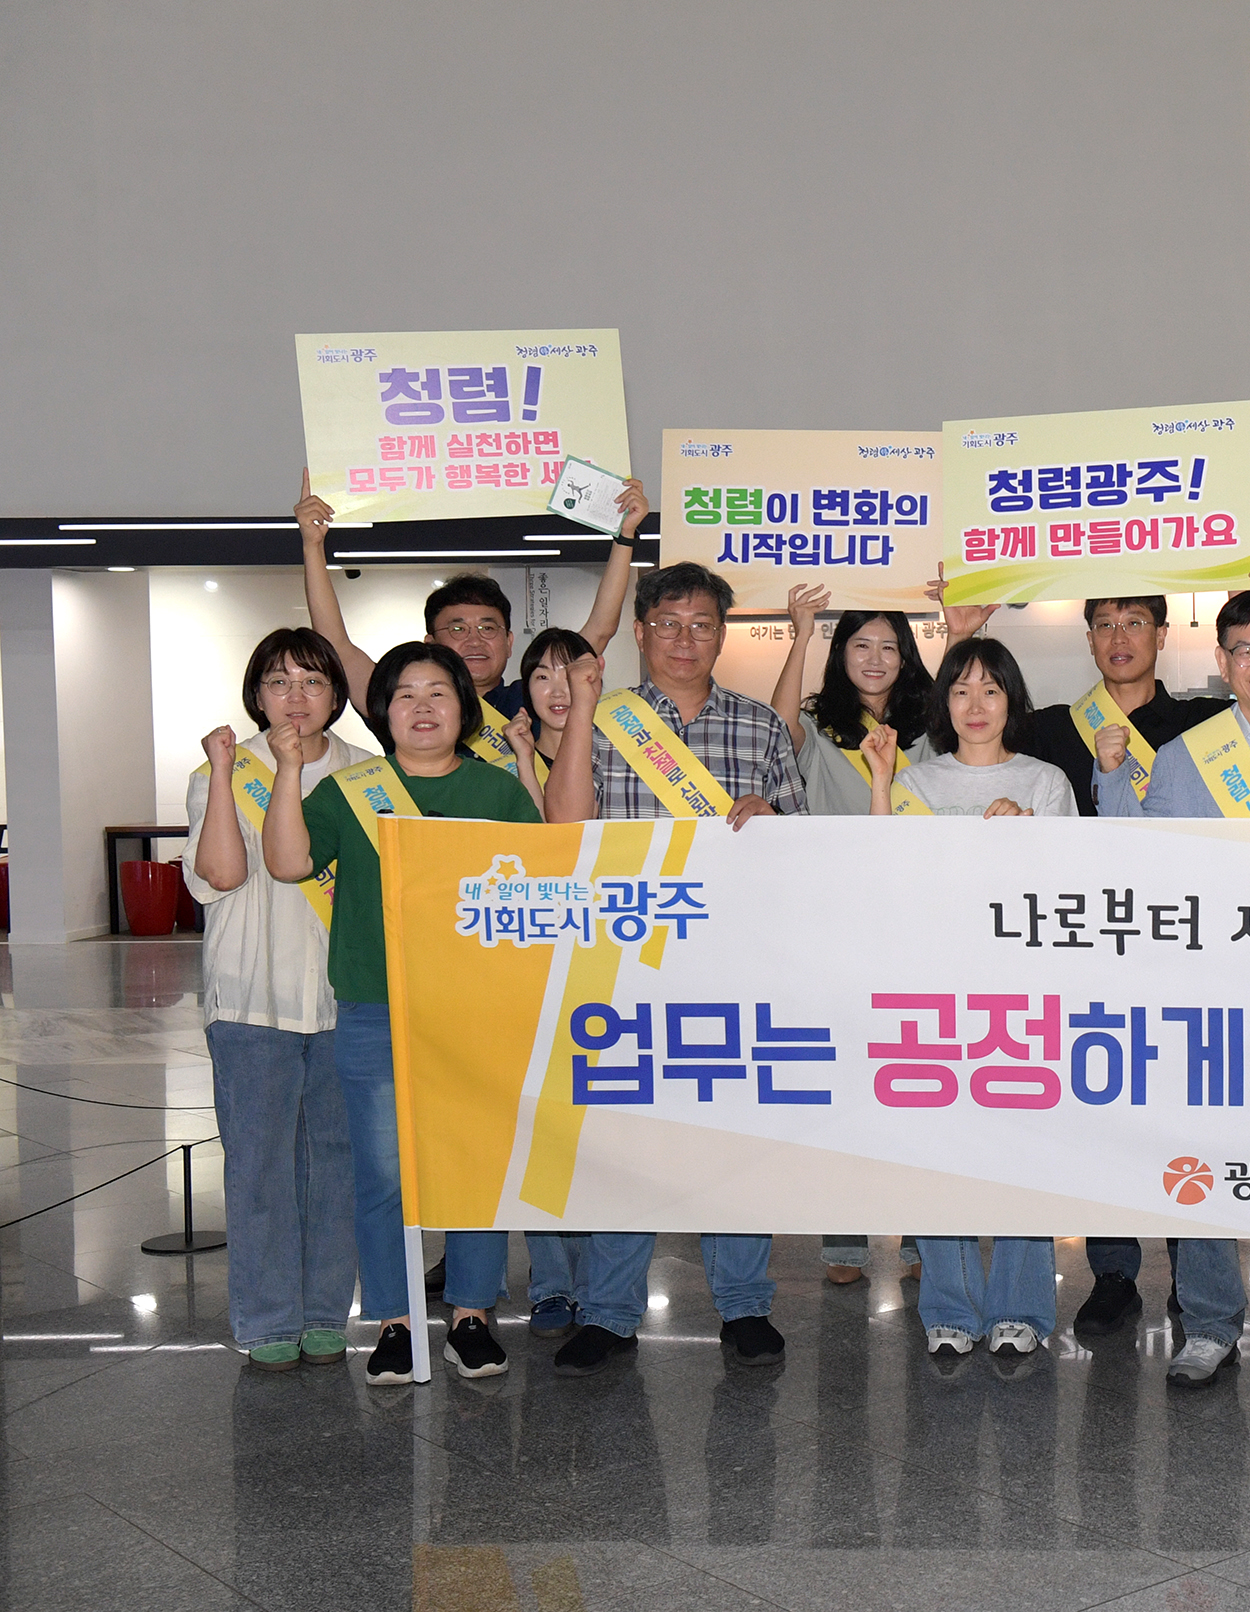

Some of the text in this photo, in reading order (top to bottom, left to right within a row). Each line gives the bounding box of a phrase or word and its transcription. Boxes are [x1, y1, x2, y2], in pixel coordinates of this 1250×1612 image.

[350, 348, 378, 363] 광주
[575, 344, 598, 358] 광주
[379, 366, 543, 425] 청렴!
[993, 431, 1019, 447] 광주
[1212, 417, 1235, 431] 광주
[379, 430, 561, 461] 함께 실천하면
[709, 444, 734, 458] 광주
[913, 446, 935, 460] 광주
[348, 464, 436, 493] 모두가
[445, 461, 530, 490] 행복한
[988, 457, 1206, 513] 청렴광주!
[684, 487, 928, 526] 청렴이 변화의
[717, 532, 894, 566] 시작입니다
[963, 513, 1238, 562] 함께 만들어가요
[539, 597, 549, 629] 일자리
[750, 625, 784, 641] 여기는
[610, 704, 650, 747] 공정과
[643, 741, 687, 787] 친절로
[243, 778, 272, 812] 청렴
[362, 784, 395, 813] 청렴
[465, 881, 589, 901] 내 일이 빛나는
[462, 881, 709, 943] 기회도시 광주
[988, 887, 1204, 957] 나로부터
[569, 1001, 837, 1105] 업무는
